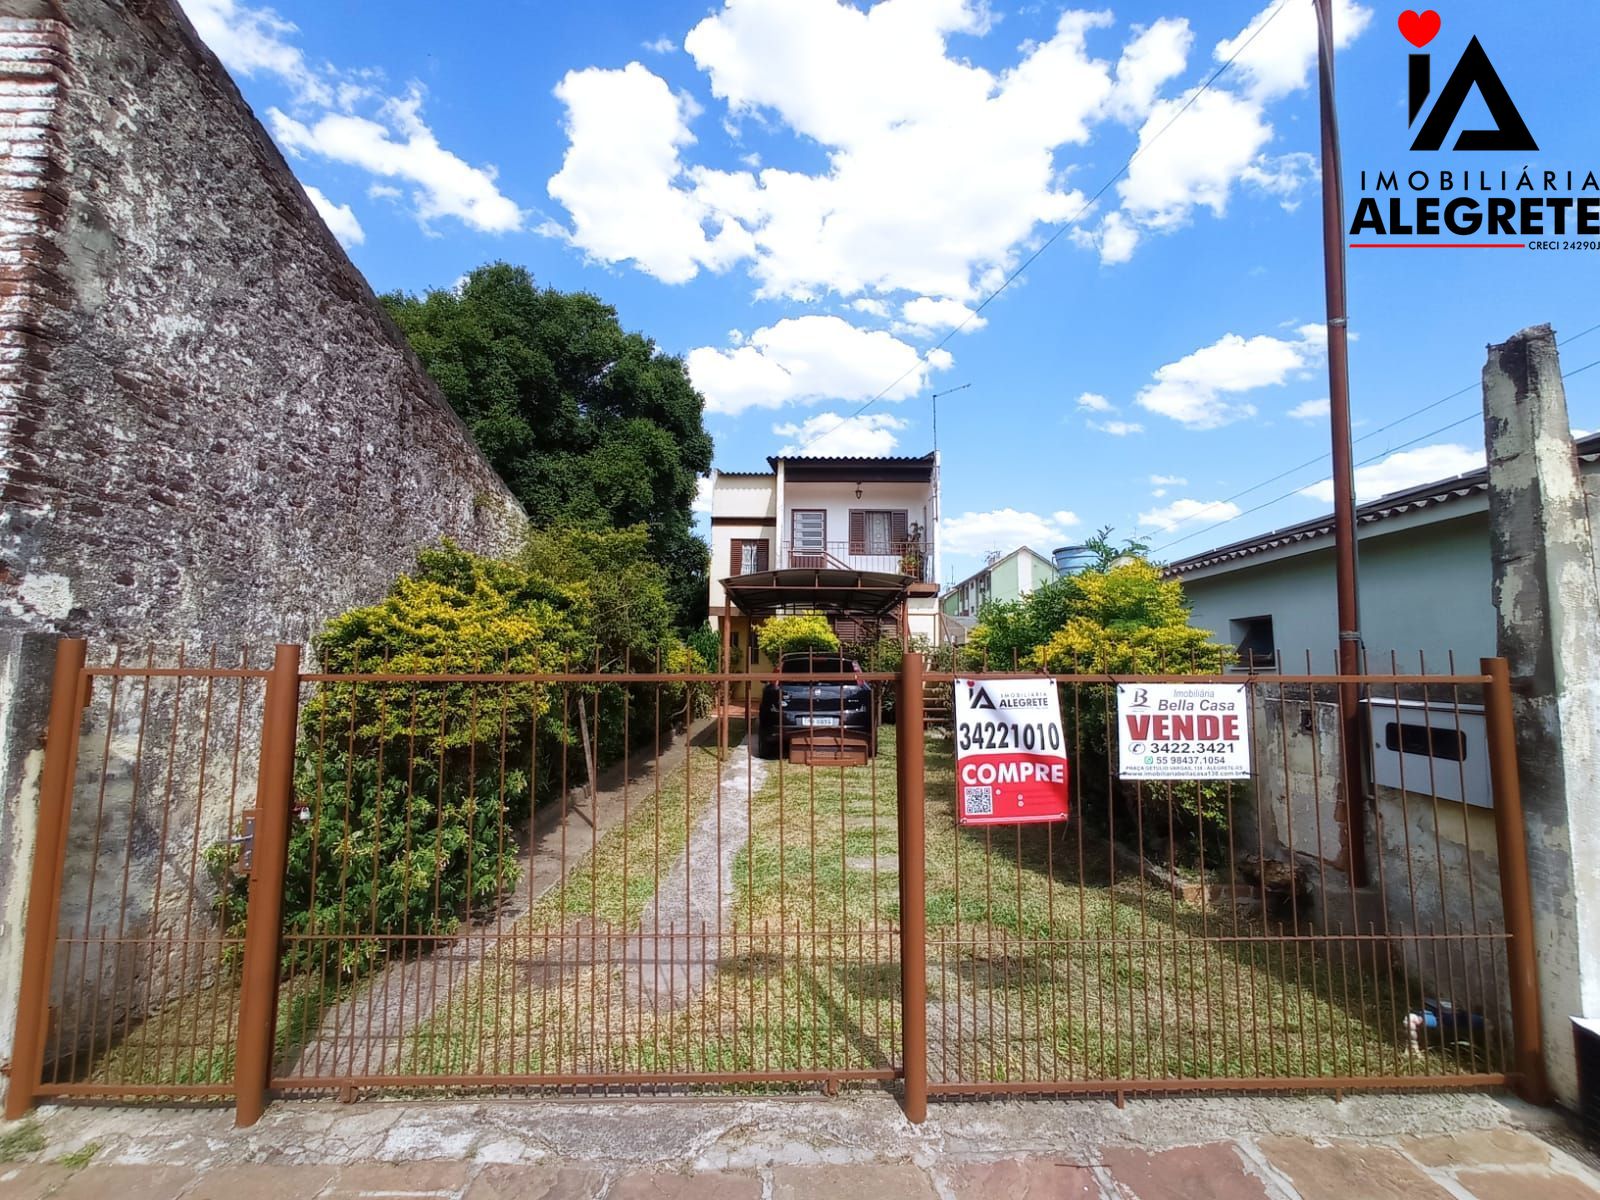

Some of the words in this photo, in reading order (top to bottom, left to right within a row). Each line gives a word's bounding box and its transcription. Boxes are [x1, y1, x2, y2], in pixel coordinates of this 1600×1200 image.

[1173, 689, 1215, 698] Imobiliária
[999, 697, 1049, 708] ALEGRETE
[1158, 699, 1194, 711] Bella
[1199, 699, 1235, 711] Casa
[1126, 714, 1240, 741] VENDE
[959, 721, 1060, 751] 34221010
[1150, 743, 1235, 754] 3422.3421
[1156, 756, 1168, 765] 55
[1170, 756, 1226, 765] 98437.1054
[961, 761, 1064, 785] COMPRE
